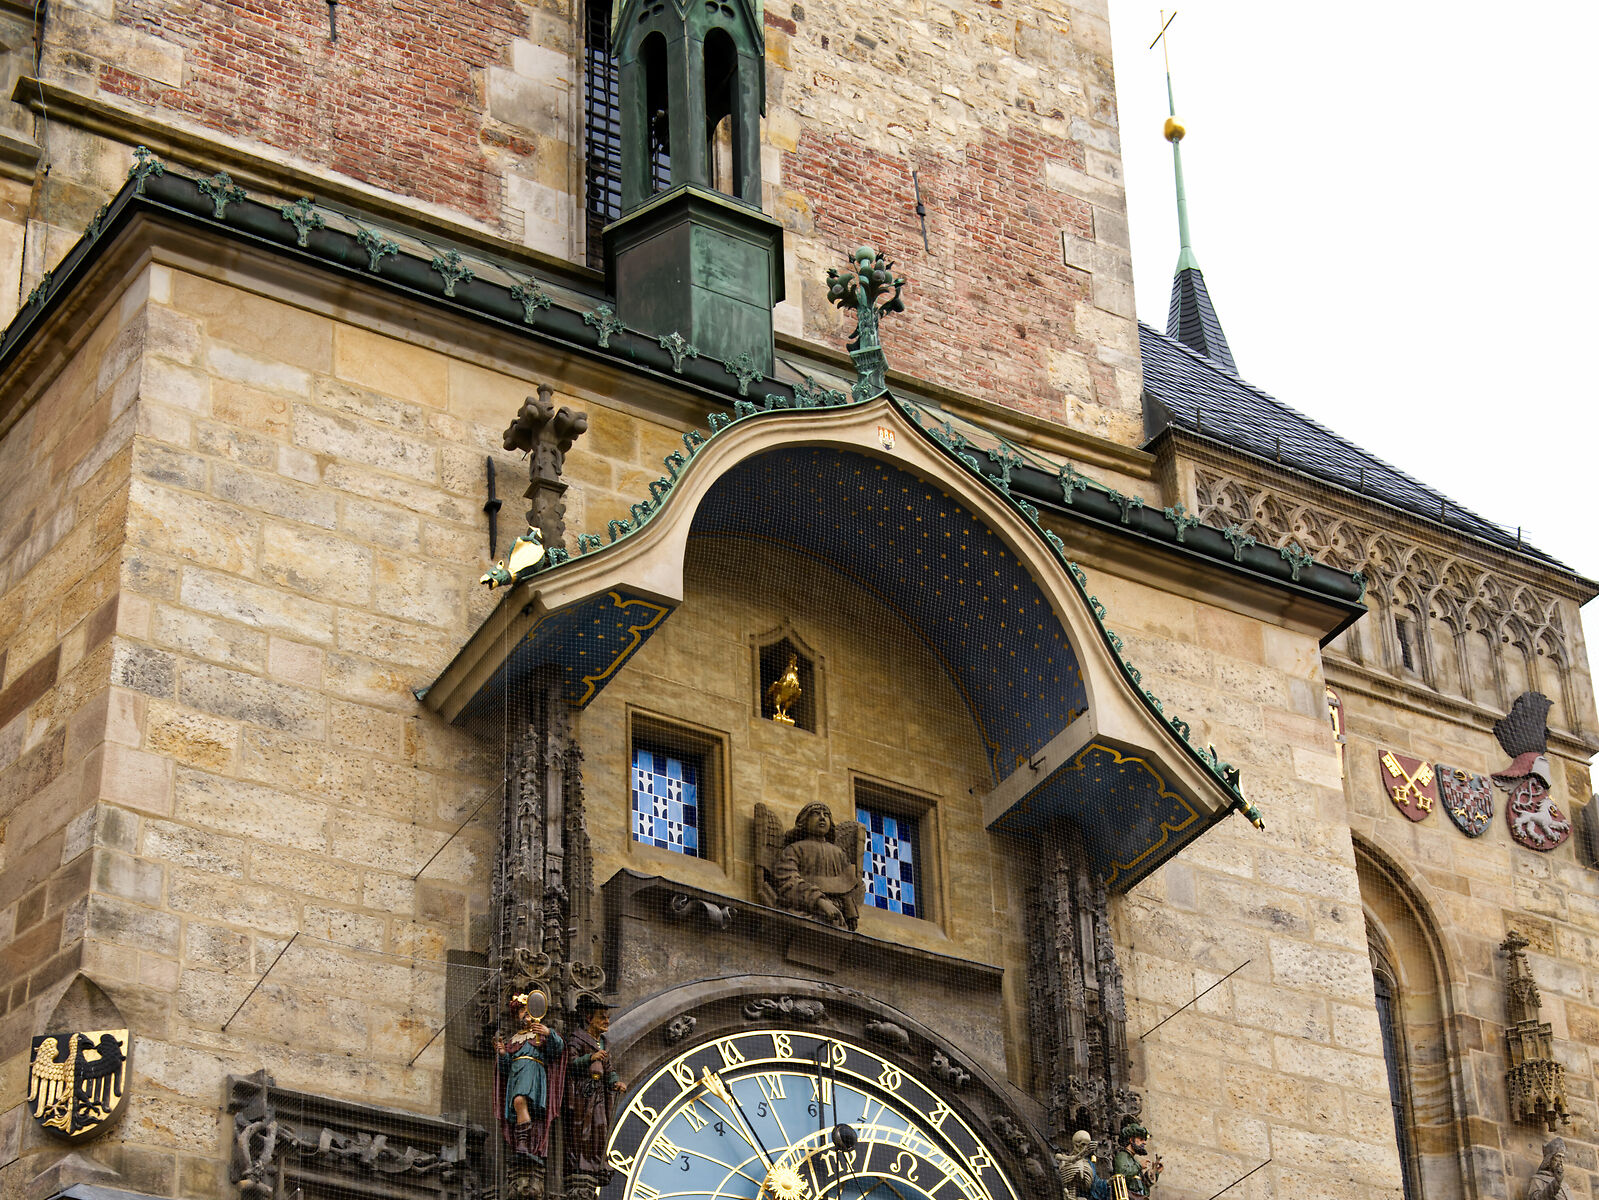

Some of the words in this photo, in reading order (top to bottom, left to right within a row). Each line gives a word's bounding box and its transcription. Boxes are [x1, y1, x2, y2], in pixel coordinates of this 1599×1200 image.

[757, 1102, 768, 1118] 5
[807, 1104, 818, 1118] 6
[713, 1121, 727, 1137] 4
[681, 1155, 691, 1172] 3
